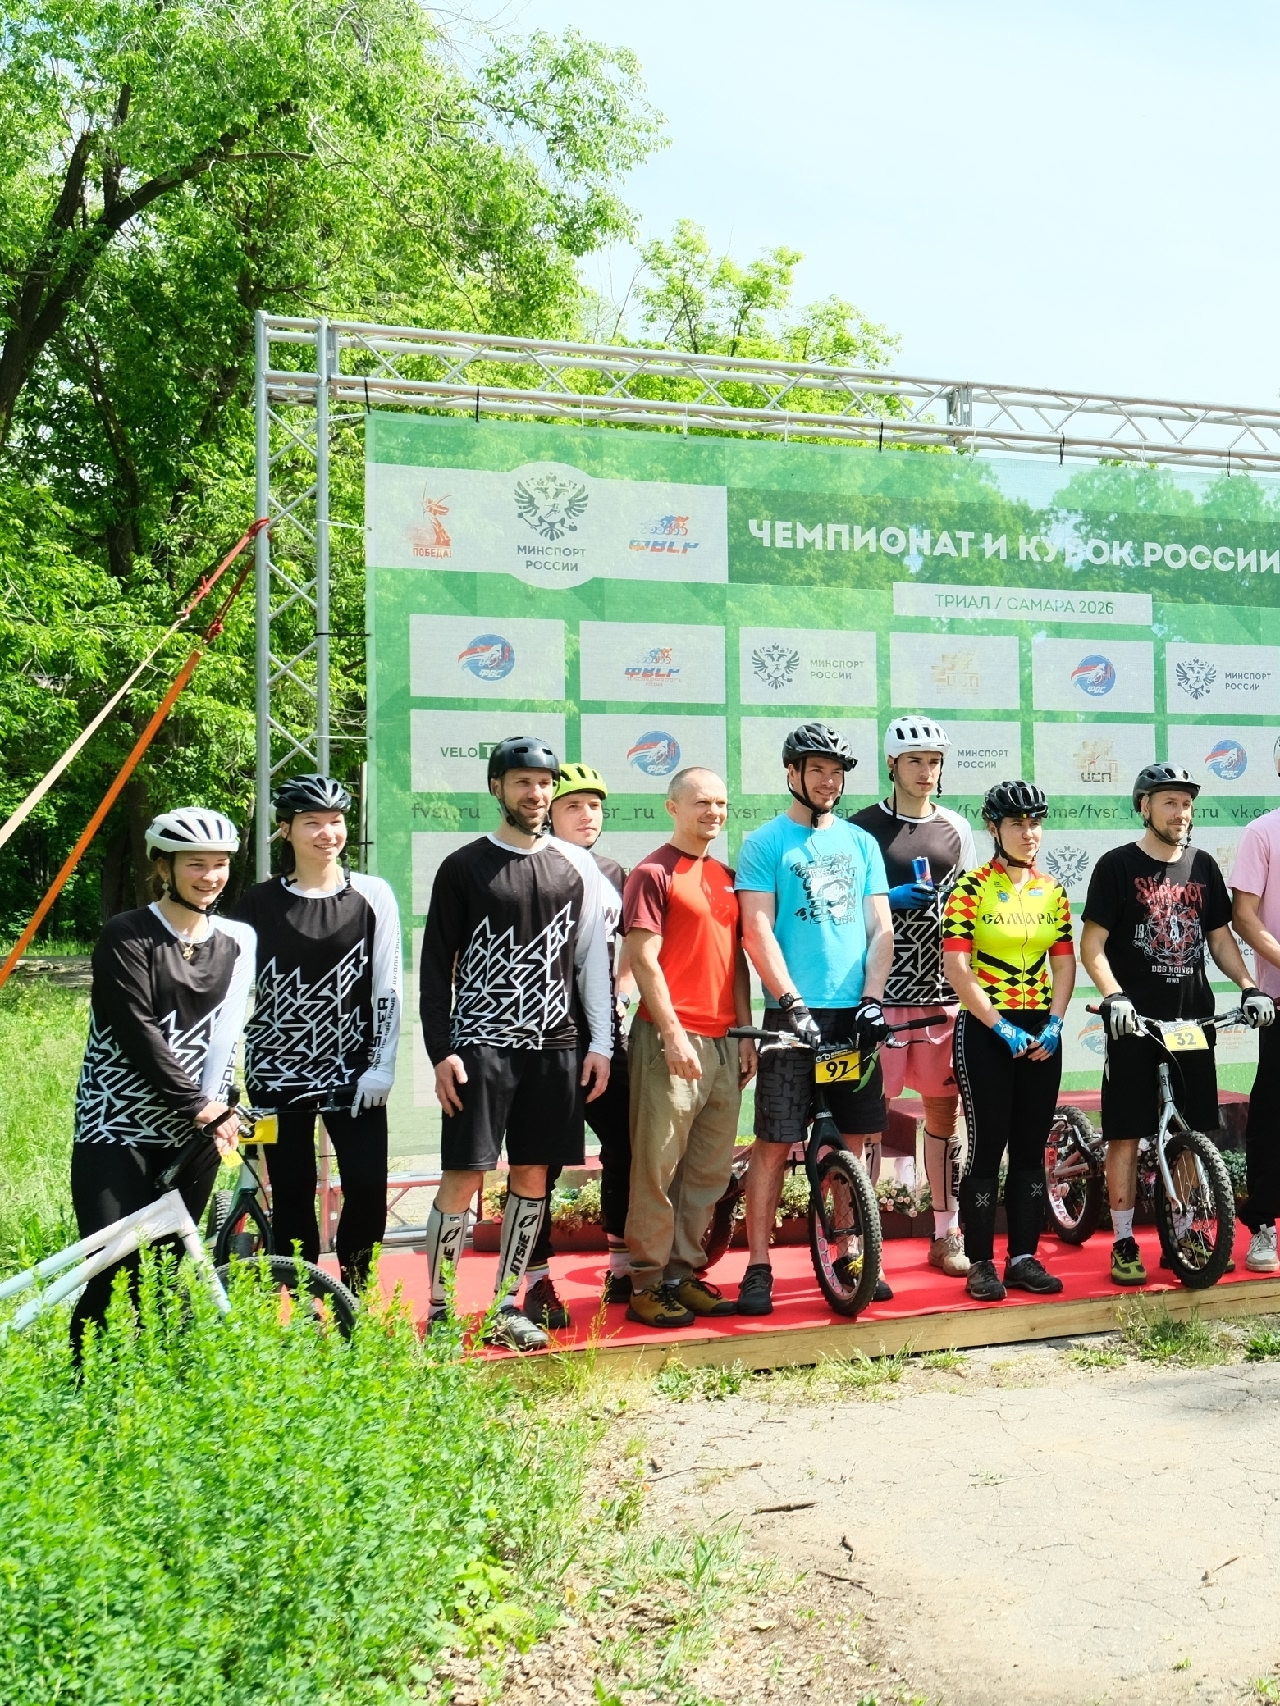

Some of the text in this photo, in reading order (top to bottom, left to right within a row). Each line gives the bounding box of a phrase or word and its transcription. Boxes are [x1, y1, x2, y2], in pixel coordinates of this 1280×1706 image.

[516, 544, 587, 558] МИНСПОРТ
[748, 519, 1280, 574] ЧЕМПИОНАТ И КУБОК РОССИИ
[525, 560, 579, 572] РОССИИ
[934, 593, 991, 610] ТРИАЛ
[1006, 596, 1075, 614] САМАРА
[1079, 599, 1115, 616] 2026
[809, 658, 865, 669] МИНСПОРТ
[809, 671, 853, 680] РОССИИ
[1224, 671, 1272, 681] МИНСПОРТ
[1224, 682, 1261, 692] РОССИИ
[956, 748, 1009, 758] МИНСПОРТ
[956, 760, 997, 769] РОССИИ
[411, 803, 481, 819] fvsr.ru
[982, 912, 1058, 925] САМАРА
[1174, 1032, 1196, 1047] 32
[826, 1060, 849, 1078] 97
